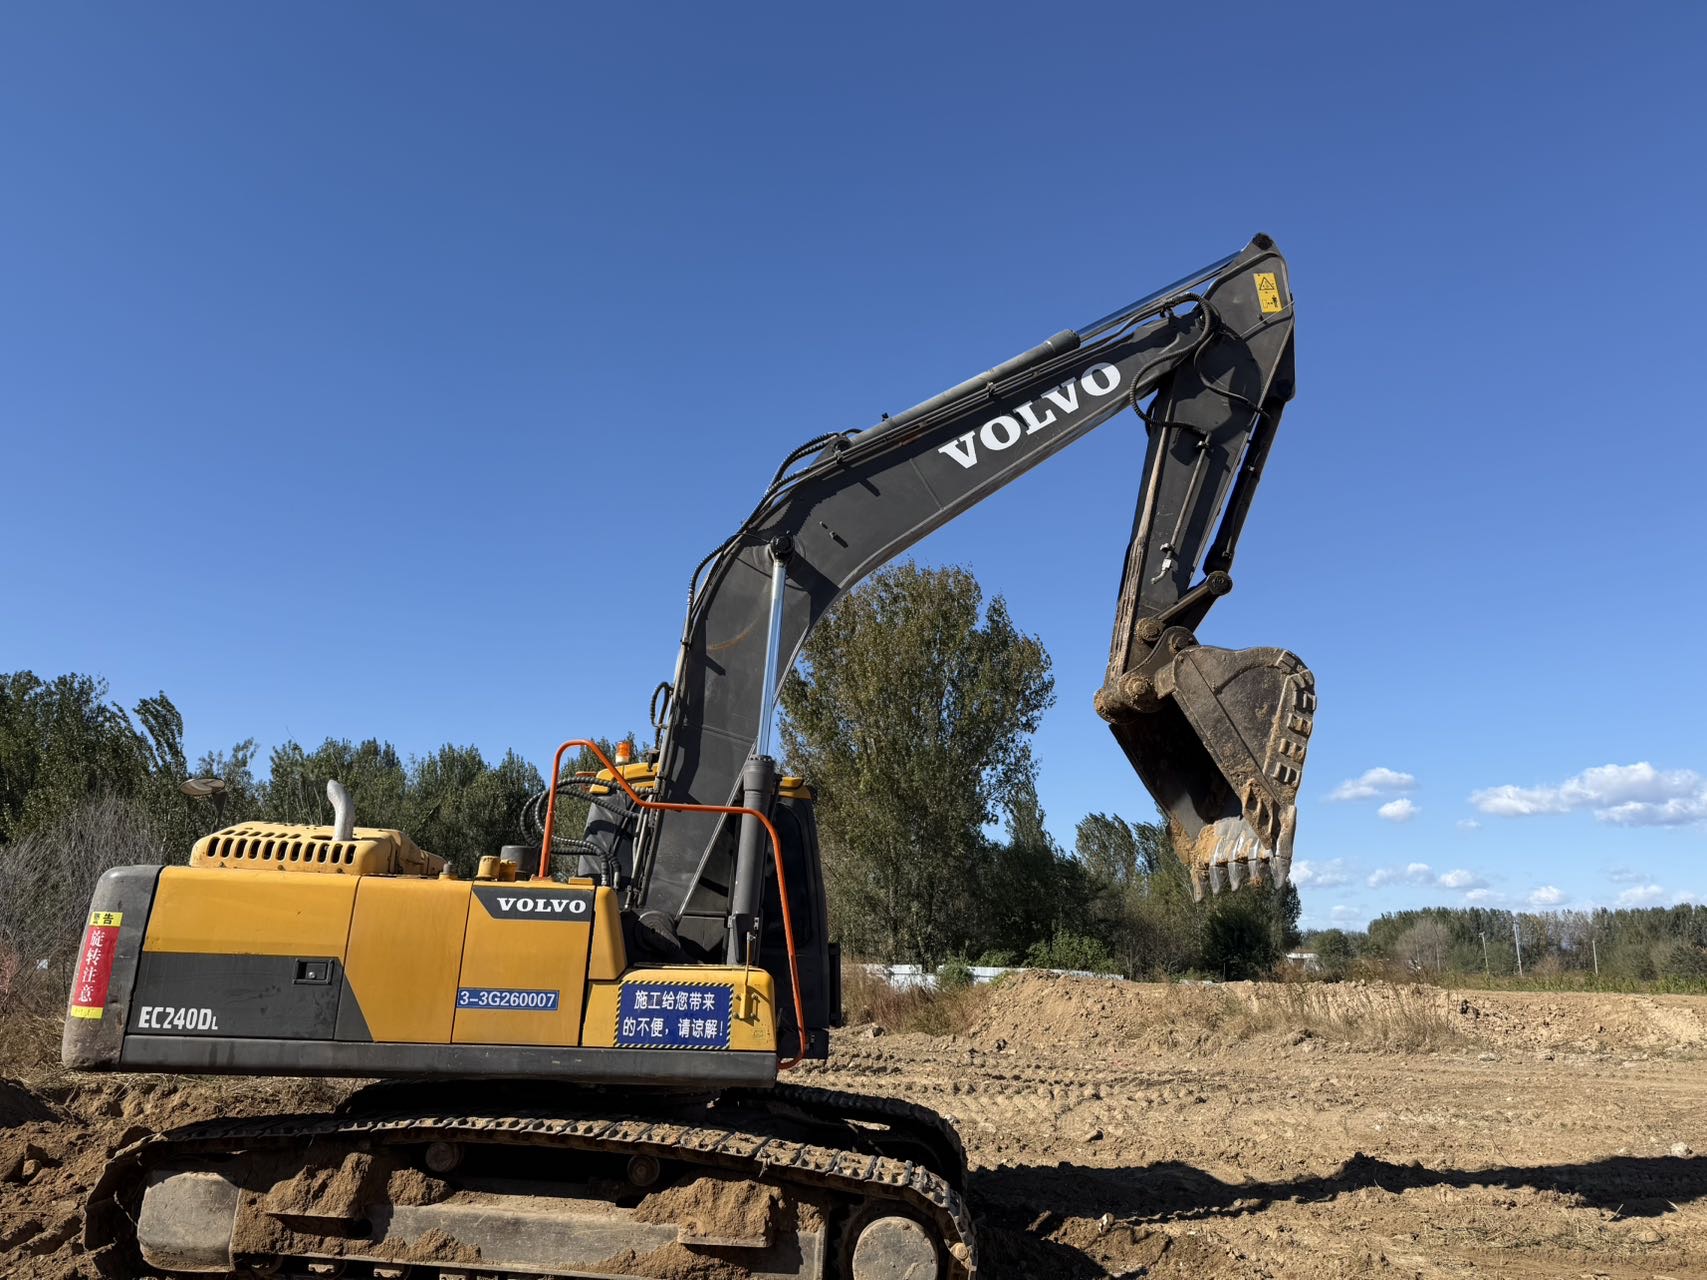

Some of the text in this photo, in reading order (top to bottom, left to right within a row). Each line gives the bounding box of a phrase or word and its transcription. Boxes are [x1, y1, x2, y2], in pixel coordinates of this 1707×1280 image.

[938, 362, 1121, 469] VOLVO
[497, 898, 586, 914] VOLVO
[460, 991, 555, 1007] 3-3G260007
[634, 990, 715, 1011] 施工给您带来
[138, 1006, 218, 1030] EC240DL
